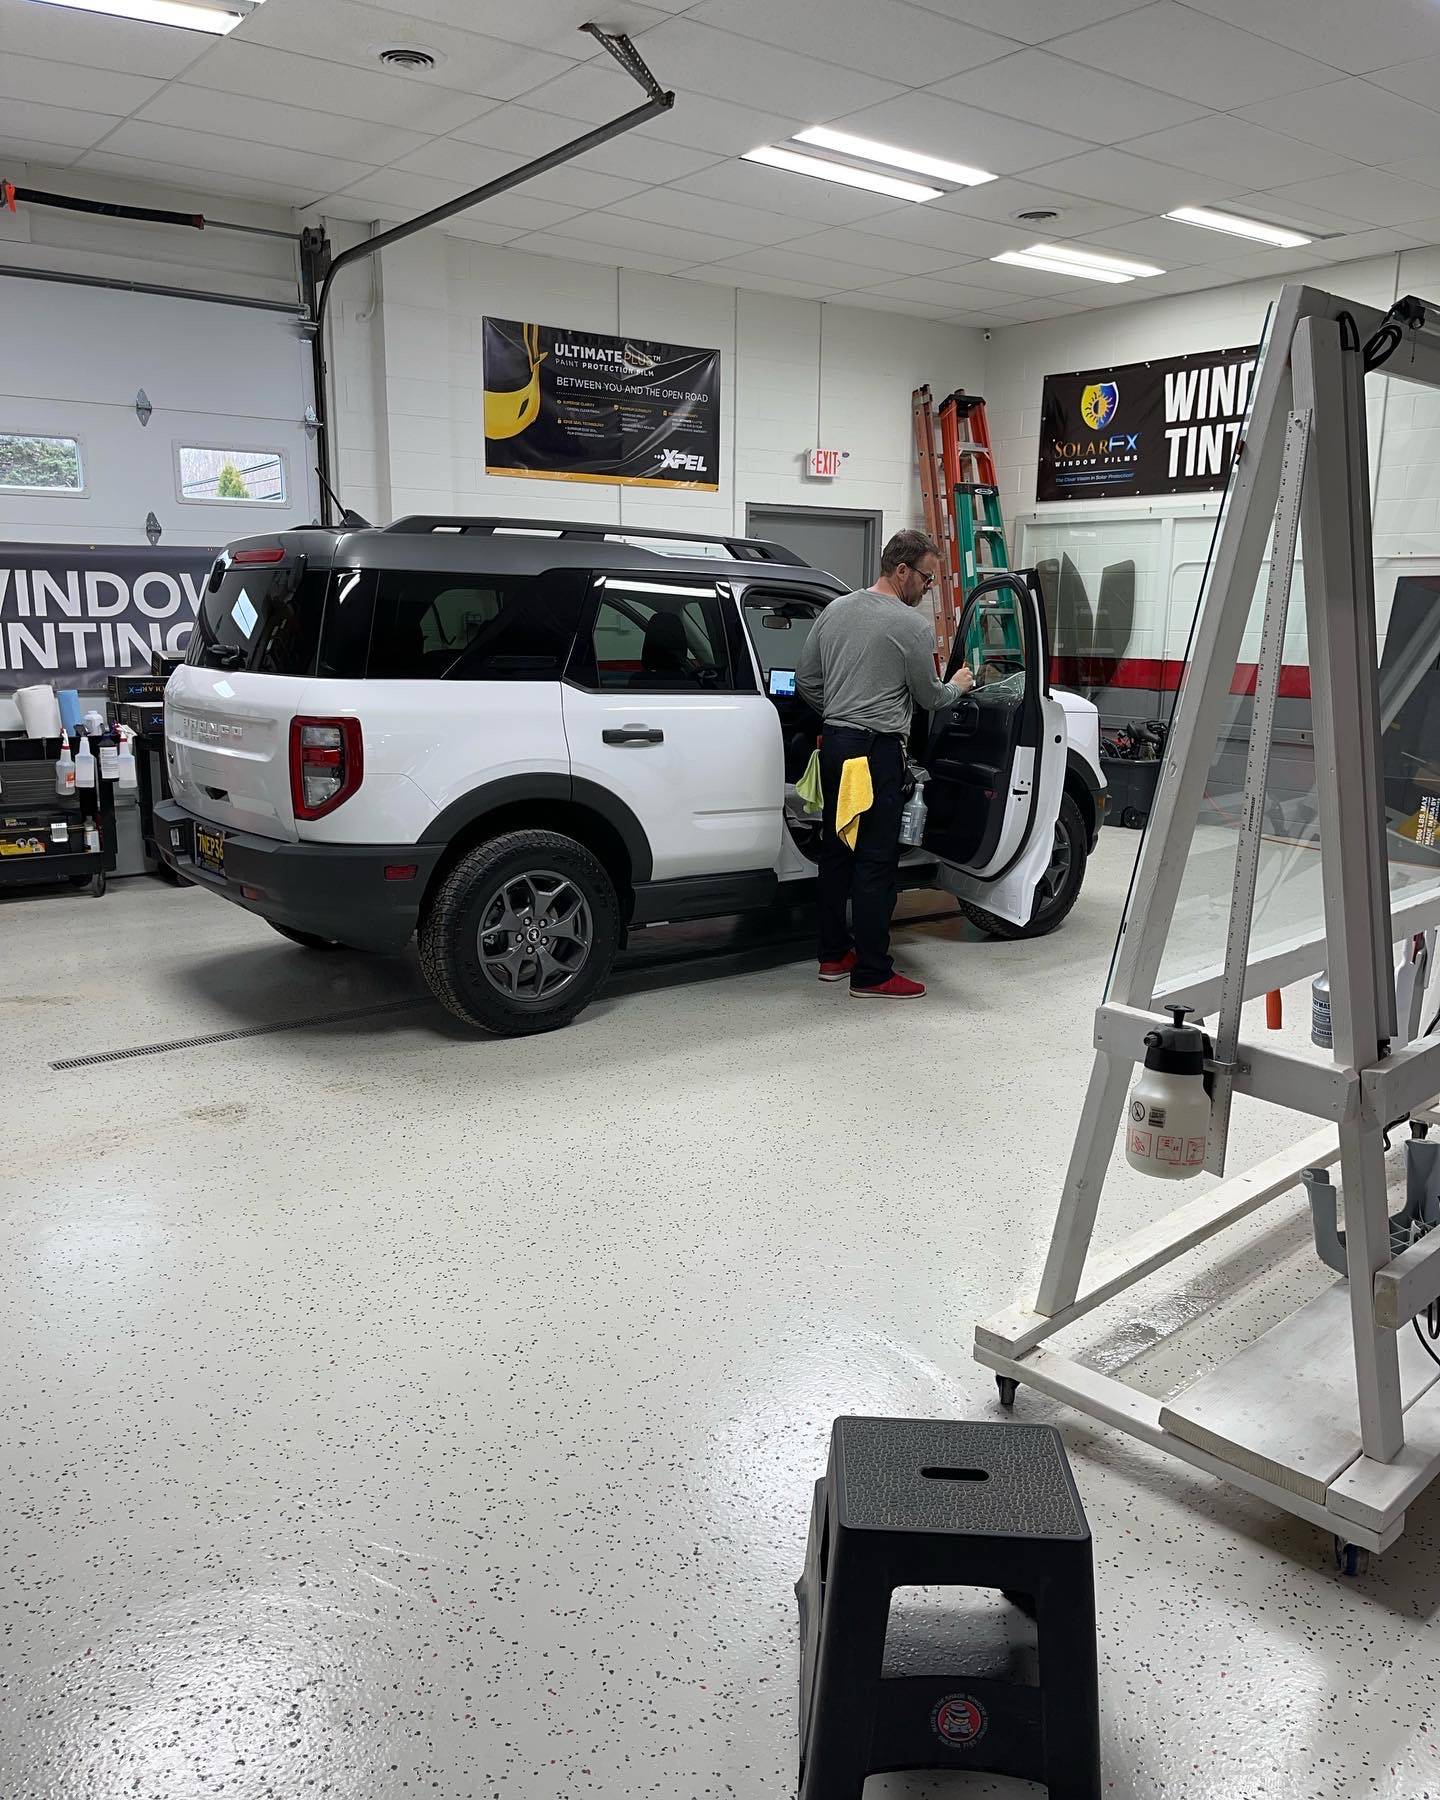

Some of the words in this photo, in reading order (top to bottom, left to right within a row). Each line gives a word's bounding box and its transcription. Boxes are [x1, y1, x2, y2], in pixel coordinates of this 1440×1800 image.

[554, 343, 623, 363] ULTIMATE
[555, 358, 579, 368] PAINT
[582, 362, 634, 375] PROTECTION
[556, 376, 602, 390] BETWEEN
[603, 382, 622, 393] YOU
[624, 384, 643, 395] AND
[645, 387, 661, 397] THE
[662, 389, 683, 400] OPEN
[685, 392, 709, 403] ROAD
[660, 448, 708, 472] XPEL
[816, 450, 839, 475] EXIT
[1054, 458, 1096, 468] WINDOW
[1104, 455, 1138, 464] FILMS
[0, 569, 211, 619] INDO
[1415, 828, 1423, 845] 1500
[1420, 796, 1428, 812] MAX
[1425, 828, 1433, 846] MADE
[1431, 796, 1437, 806] BY
